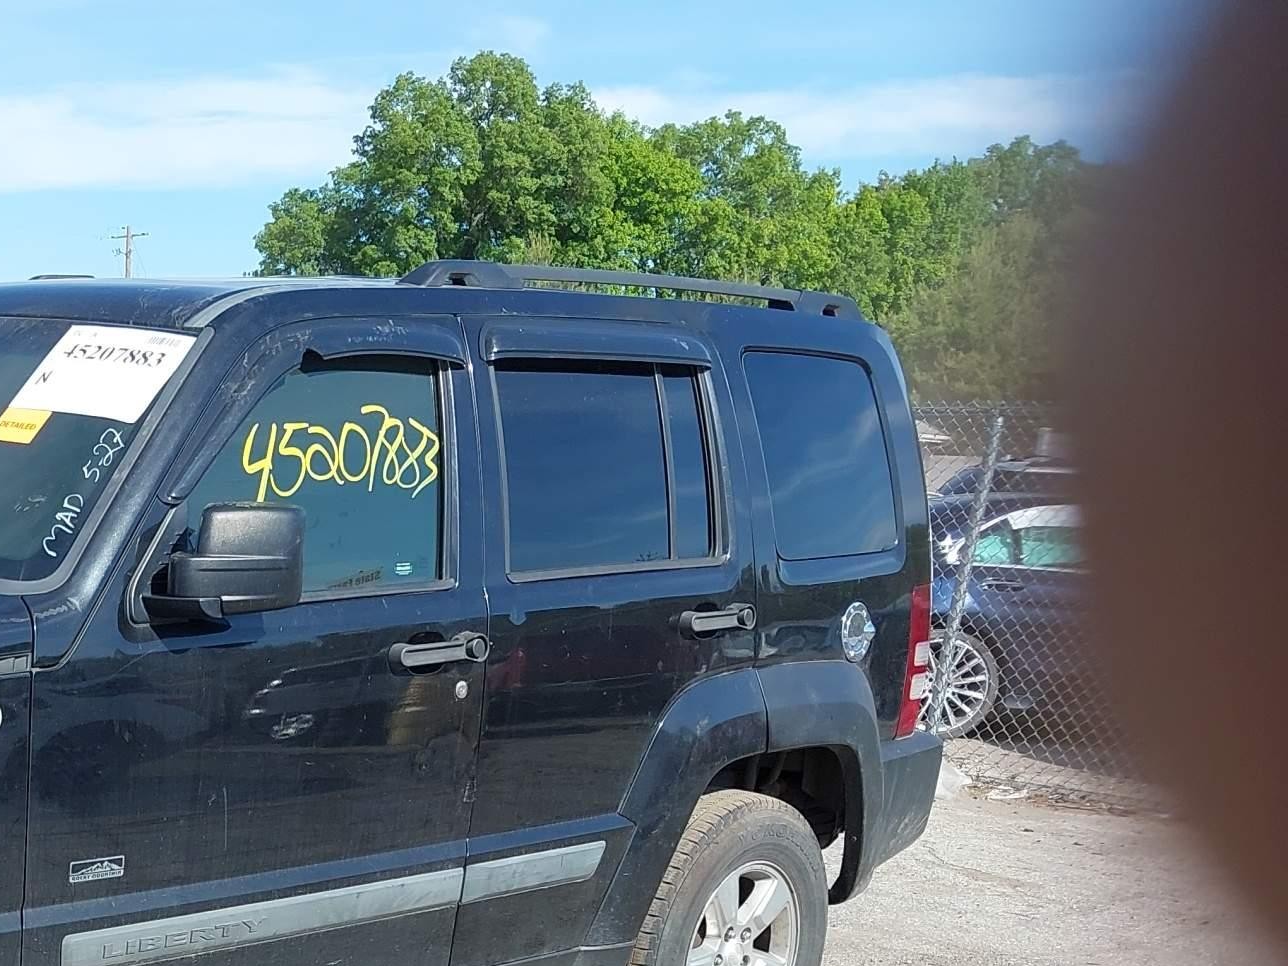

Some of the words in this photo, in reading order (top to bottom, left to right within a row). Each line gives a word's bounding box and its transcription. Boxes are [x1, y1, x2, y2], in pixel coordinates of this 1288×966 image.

[64, 343, 166, 367] 45207883
[35, 370, 53, 385] N
[0, 420, 37, 431] DETAILED
[242, 405, 439, 502] 45207883
[42, 493, 84, 557] MAD
[82, 427, 125, 483] 5-27
[102, 917, 266, 960] LIBERTY
